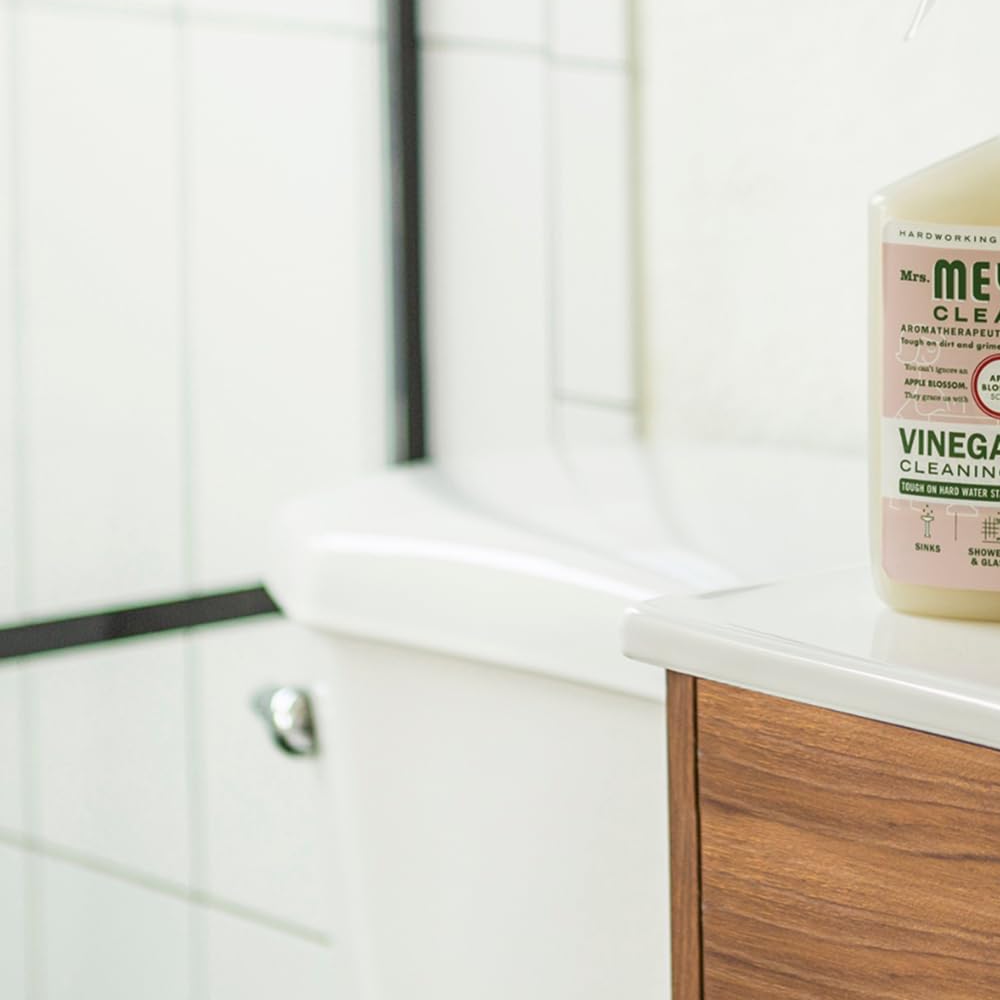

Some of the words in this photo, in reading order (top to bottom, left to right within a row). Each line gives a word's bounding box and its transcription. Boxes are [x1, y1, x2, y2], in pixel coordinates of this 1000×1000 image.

[899, 230, 997, 243] HARDWORKING
[900, 270, 930, 283] Mrs.
[901, 337, 923, 346] Tough
[939, 340, 954, 348] dirt
[905, 378, 926, 386] APPLE
[902, 482, 925, 493] TOUGH
[926, 485, 937, 494] ON
[939, 486, 959, 496] HARD
[961, 487, 987, 497] WATER
[915, 542, 941, 553] SINKS
[970, 558, 978, 566] &
